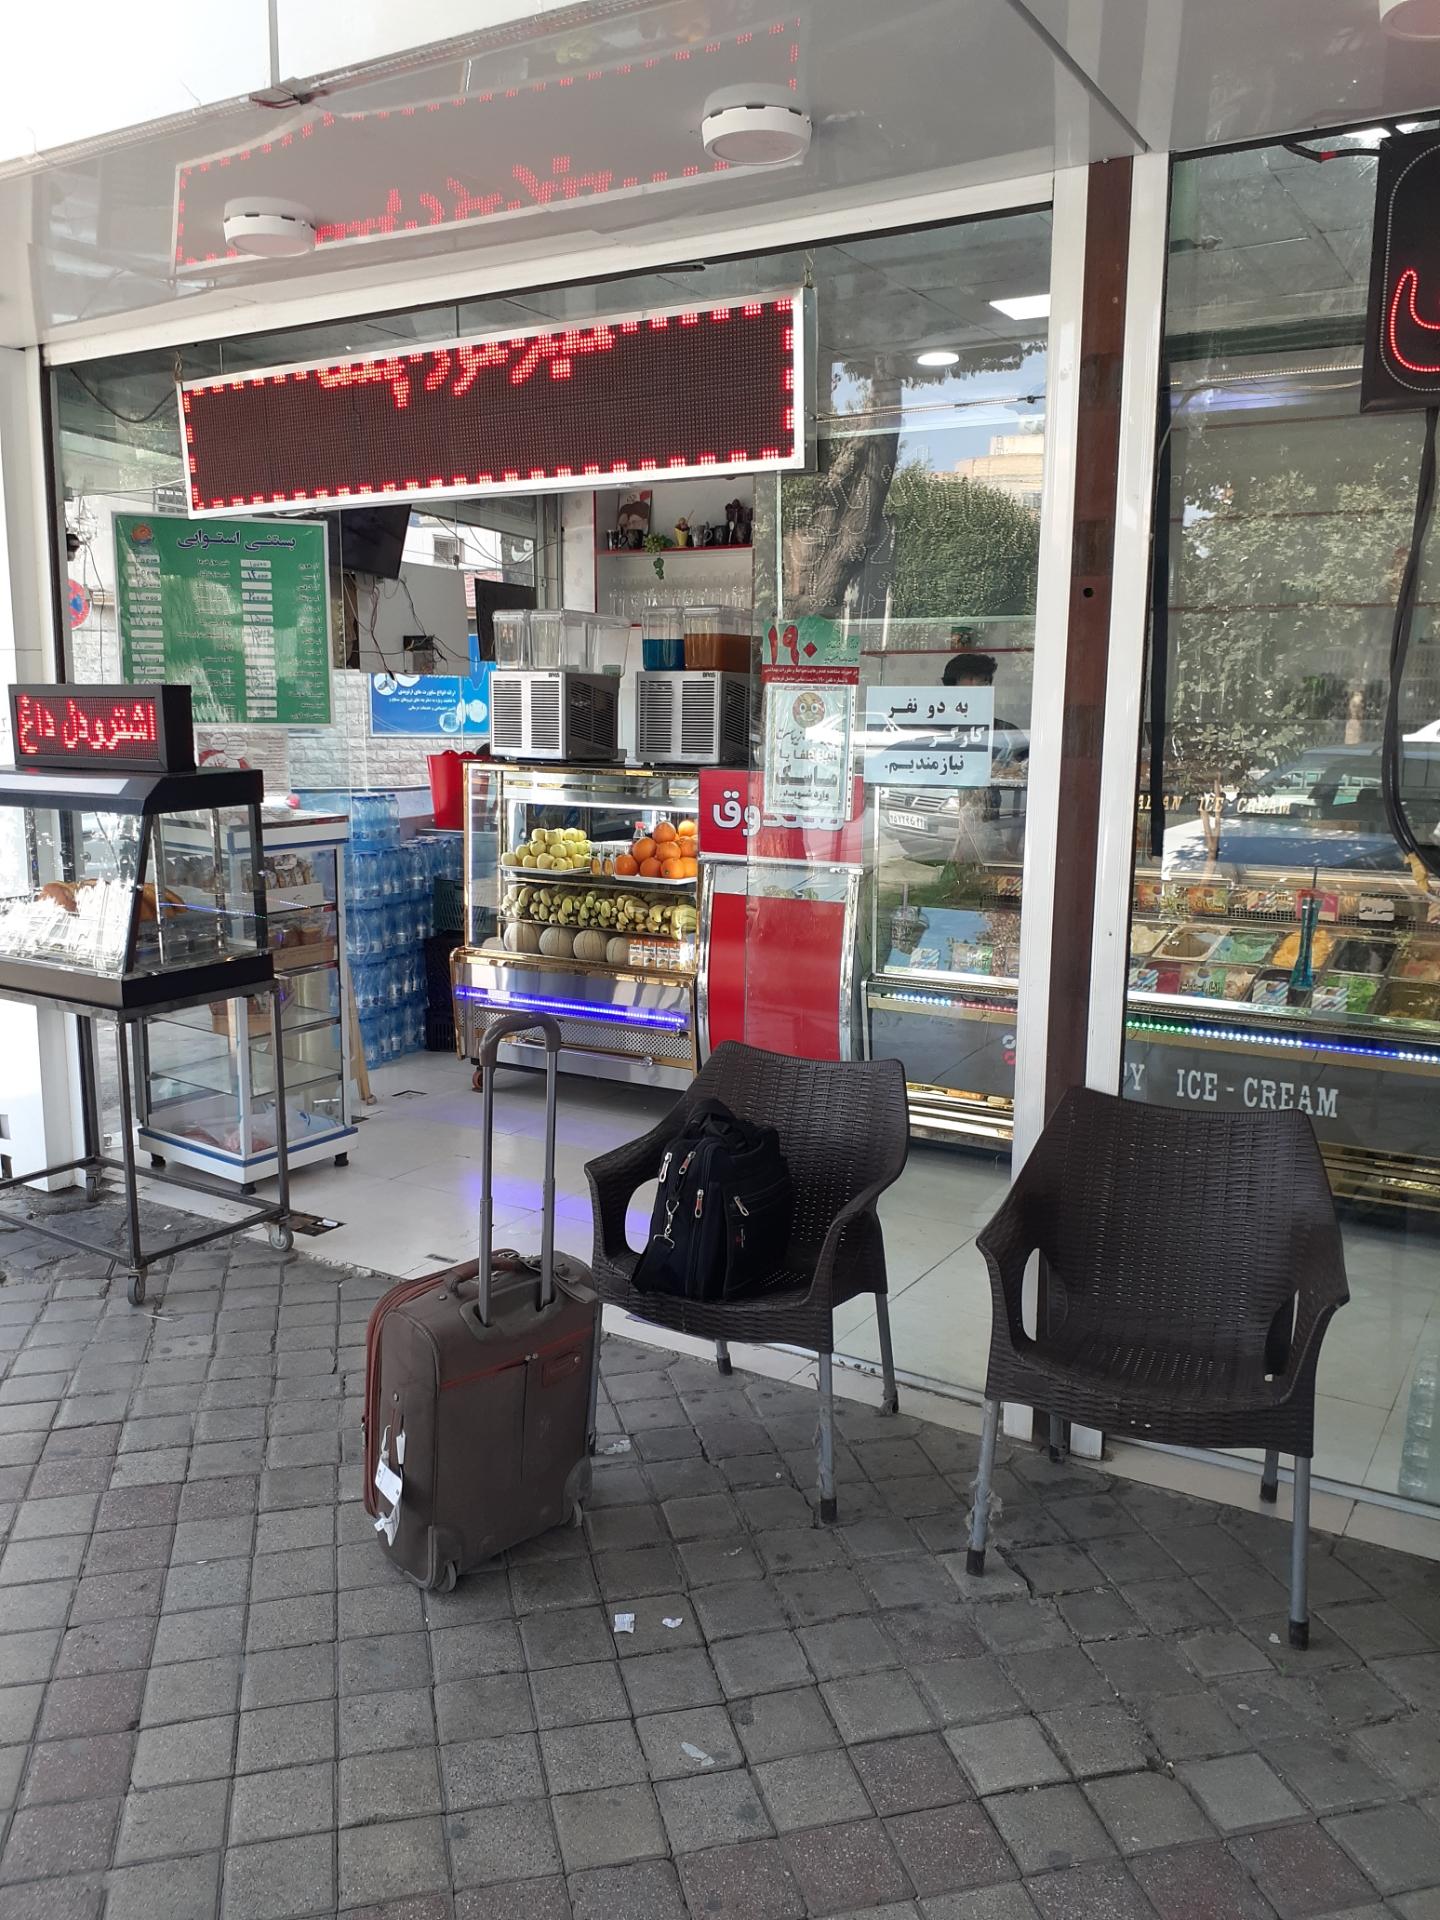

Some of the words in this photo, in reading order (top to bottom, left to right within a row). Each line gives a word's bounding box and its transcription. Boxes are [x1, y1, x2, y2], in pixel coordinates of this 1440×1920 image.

[244, 534, 297, 551] بستنی
[888, 698, 918, 718] نفر
[927, 701, 946, 719] دو
[955, 701, 968, 718] به
[19, 695, 56, 753] داغ
[63, 700, 157, 749] اشترودل
[929, 726, 985, 748] کارگر
[1198, 796, 1224, 812] ICE
[1176, 1068, 1218, 1102] ICE
[1243, 1077, 1339, 1118] CREAM
